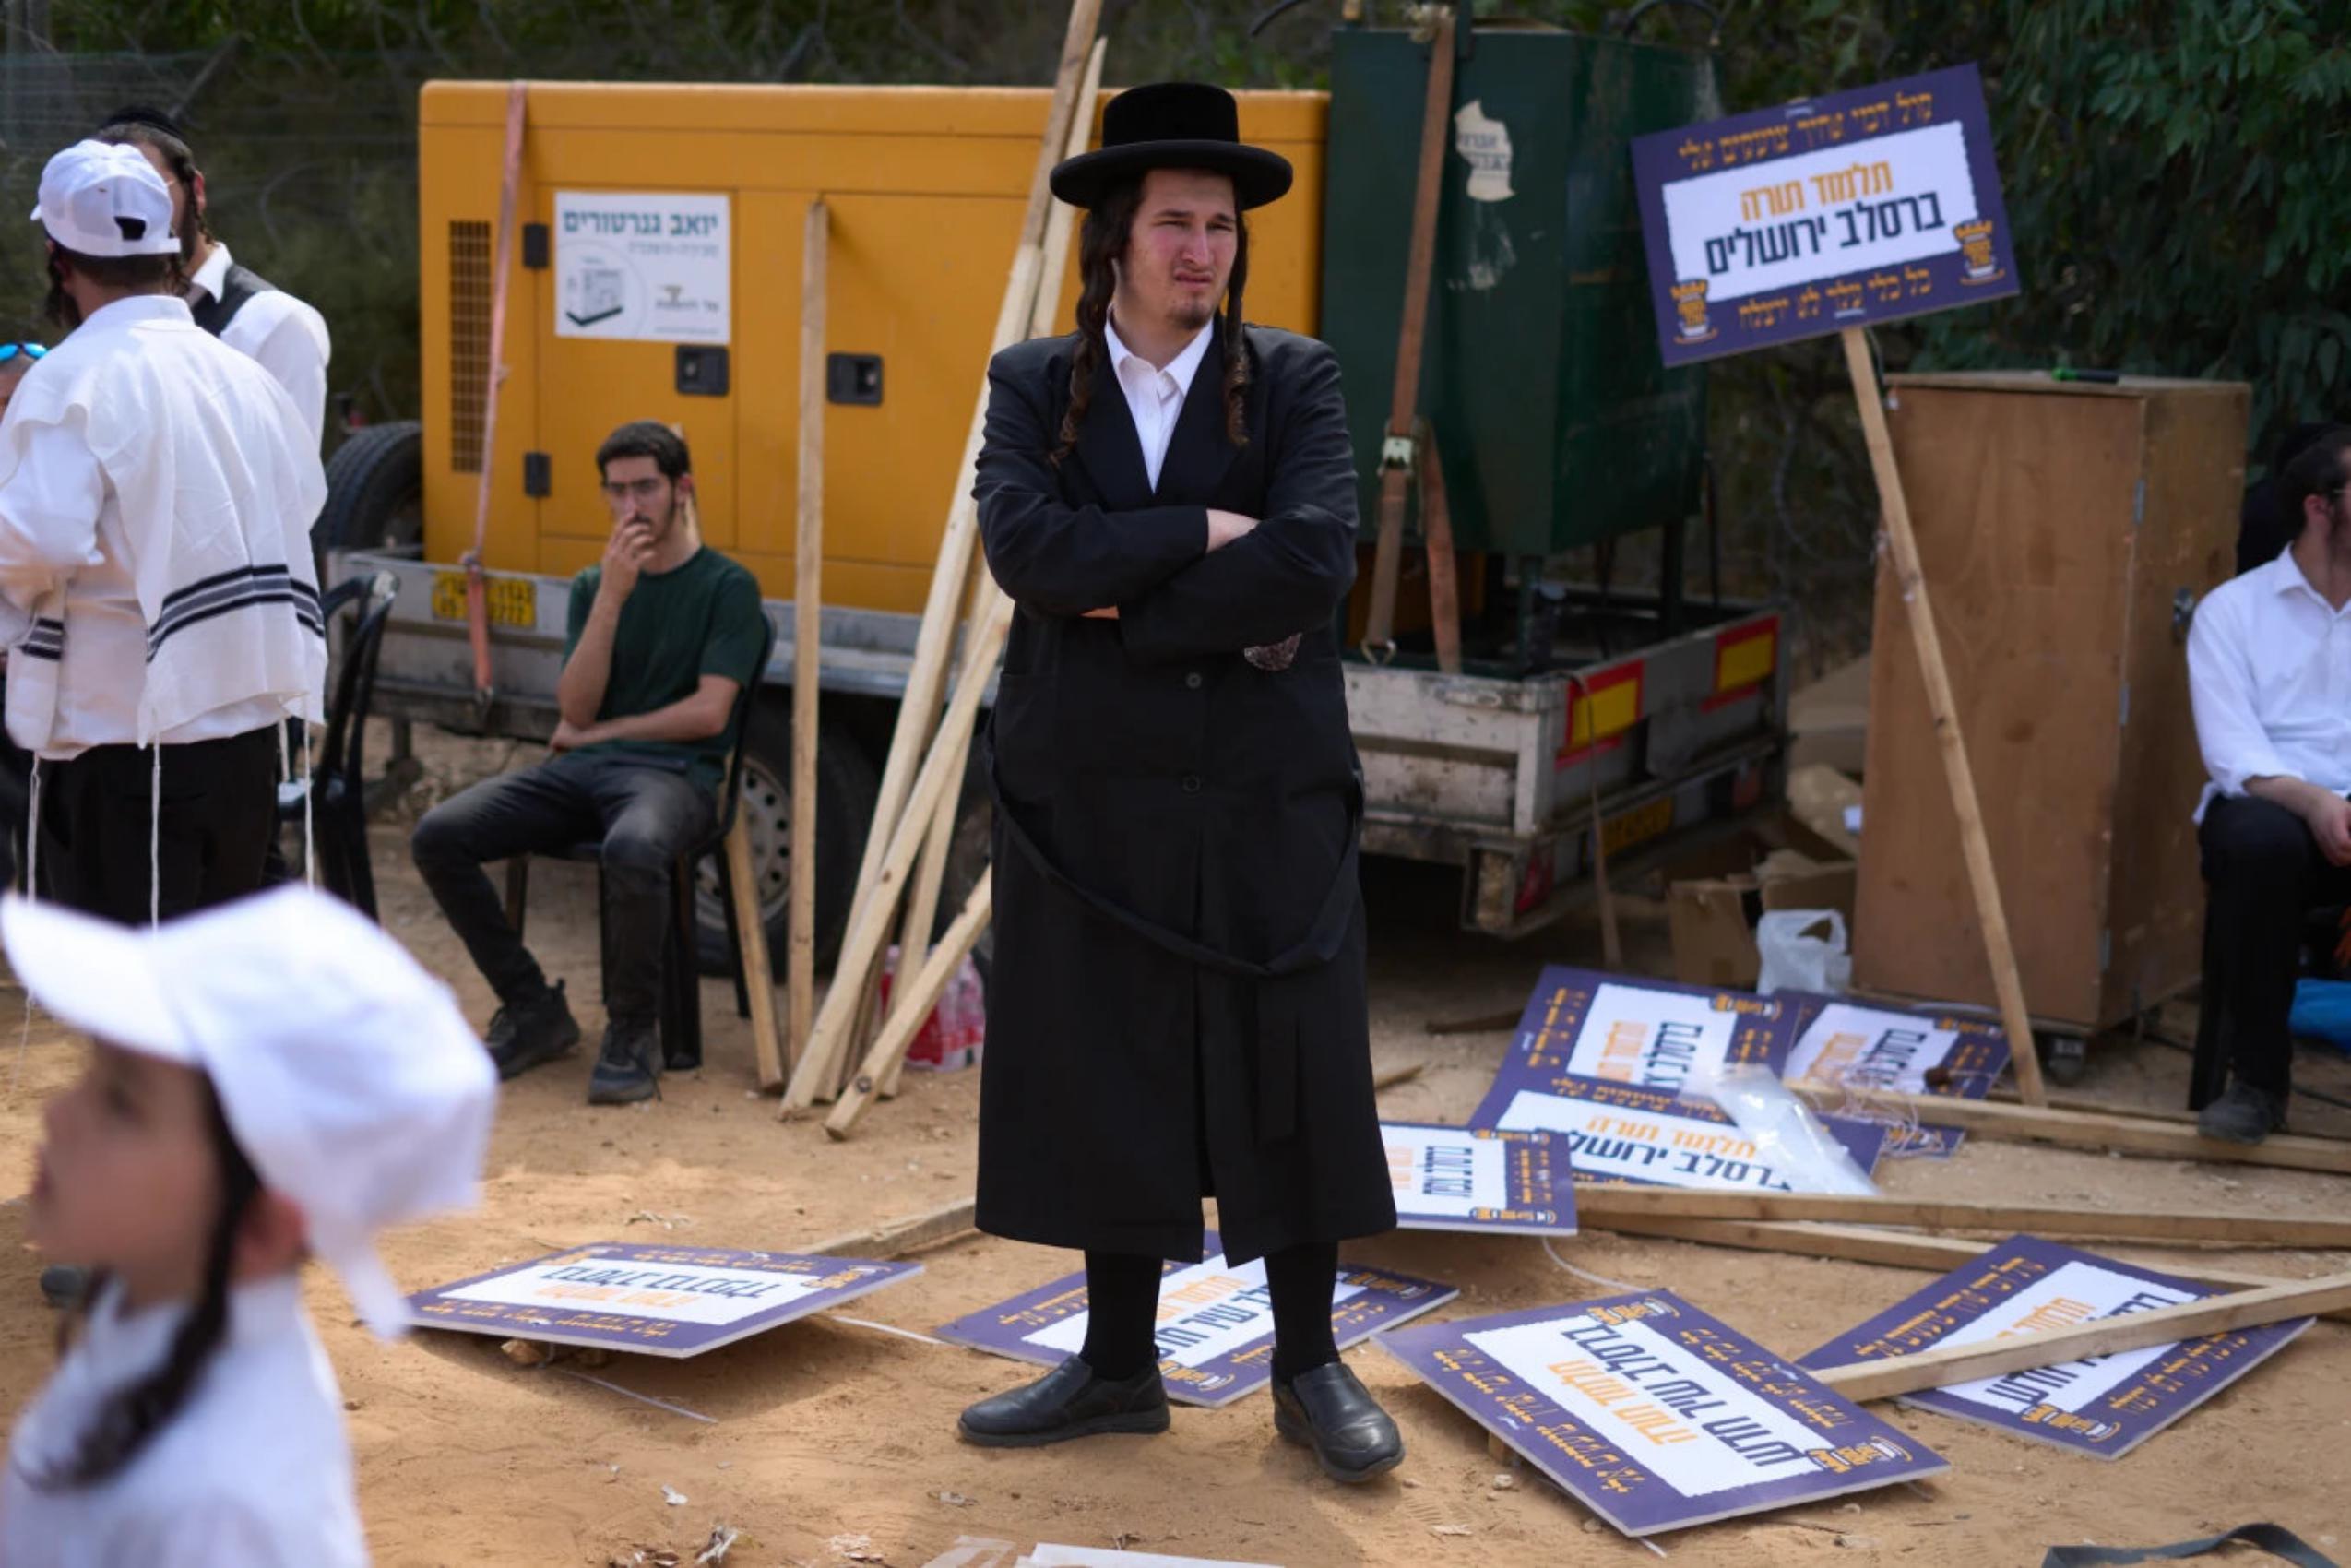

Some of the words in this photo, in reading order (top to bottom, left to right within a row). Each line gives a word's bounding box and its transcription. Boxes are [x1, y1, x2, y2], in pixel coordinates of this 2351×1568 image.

[1741, 181, 1805, 221] תורה
[1810, 161, 1893, 205] תלמוד
[563, 210, 662, 233] גנרטורים
[668, 213, 719, 235] יואב
[1836, 192, 1944, 247] ברסלב
[1704, 216, 1826, 275] ירושלים
[1585, 1114, 1661, 1142] תורה
[1671, 1127, 1757, 1159] תלמוד
[1673, 1150, 1793, 1193] רסלב
[1179, 1304, 1259, 1329] שיר
[1549, 1359, 1633, 1407] תלמוד
[1614, 1405, 1697, 1445] תורה
[1561, 1323, 1679, 1381] ברסלב
[1644, 1380, 1726, 1419] שיר
[1702, 1417, 1810, 1466] חדש
